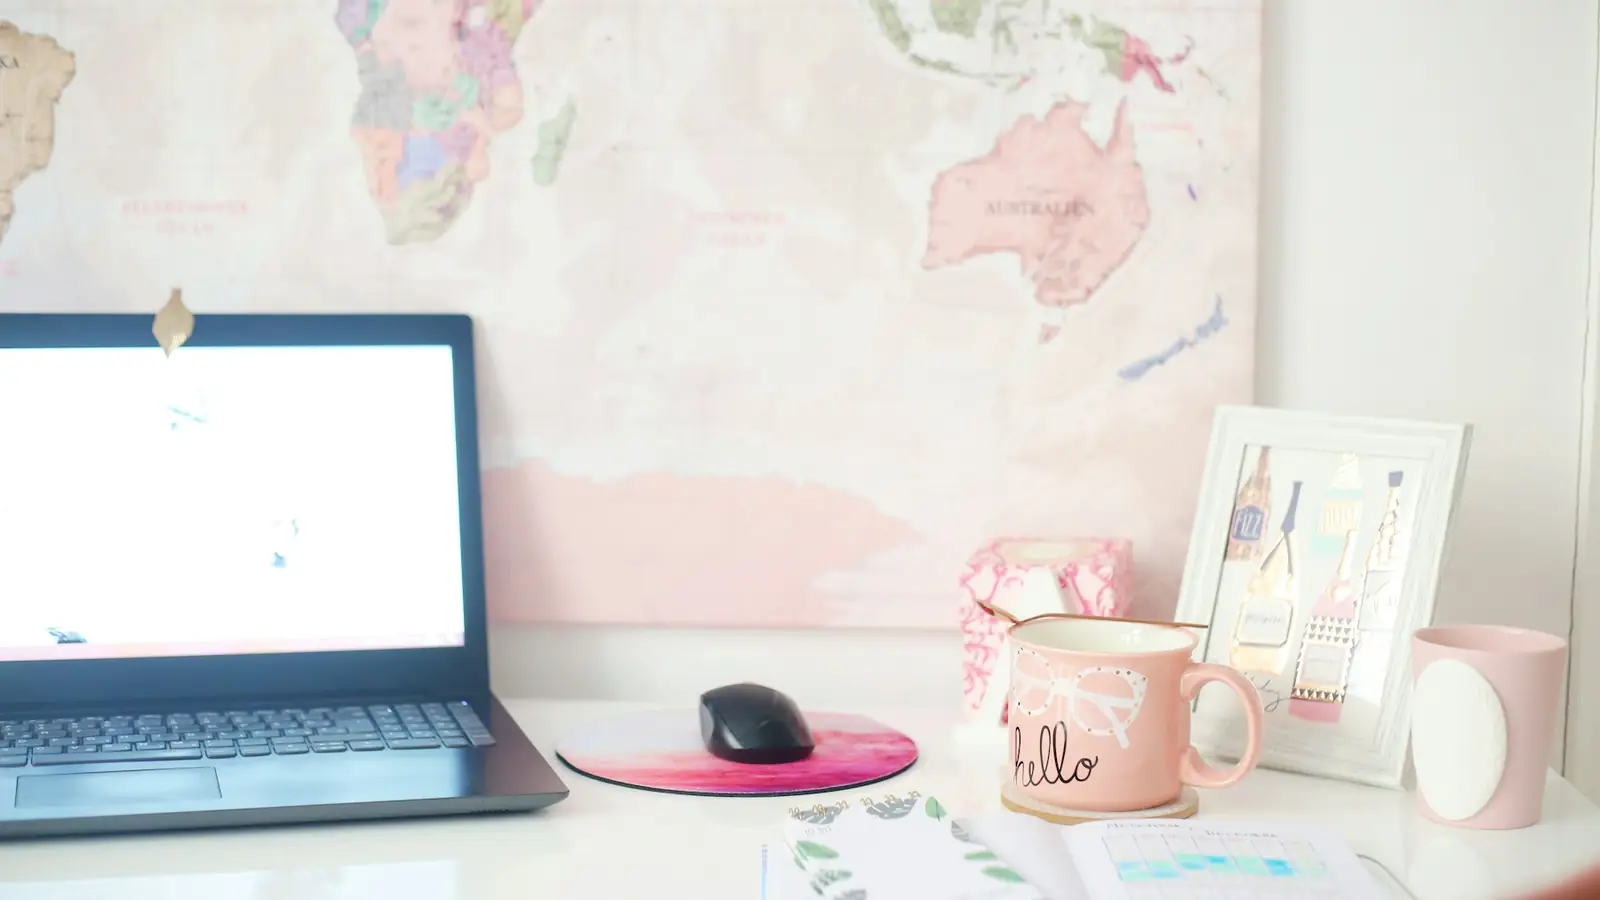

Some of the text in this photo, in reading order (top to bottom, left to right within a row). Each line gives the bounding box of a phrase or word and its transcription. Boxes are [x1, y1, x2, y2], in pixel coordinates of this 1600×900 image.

[985, 200, 1096, 217] AUSTRALIEN
[1231, 508, 1255, 531] FIZZ
[1013, 721, 1099, 787] hello
